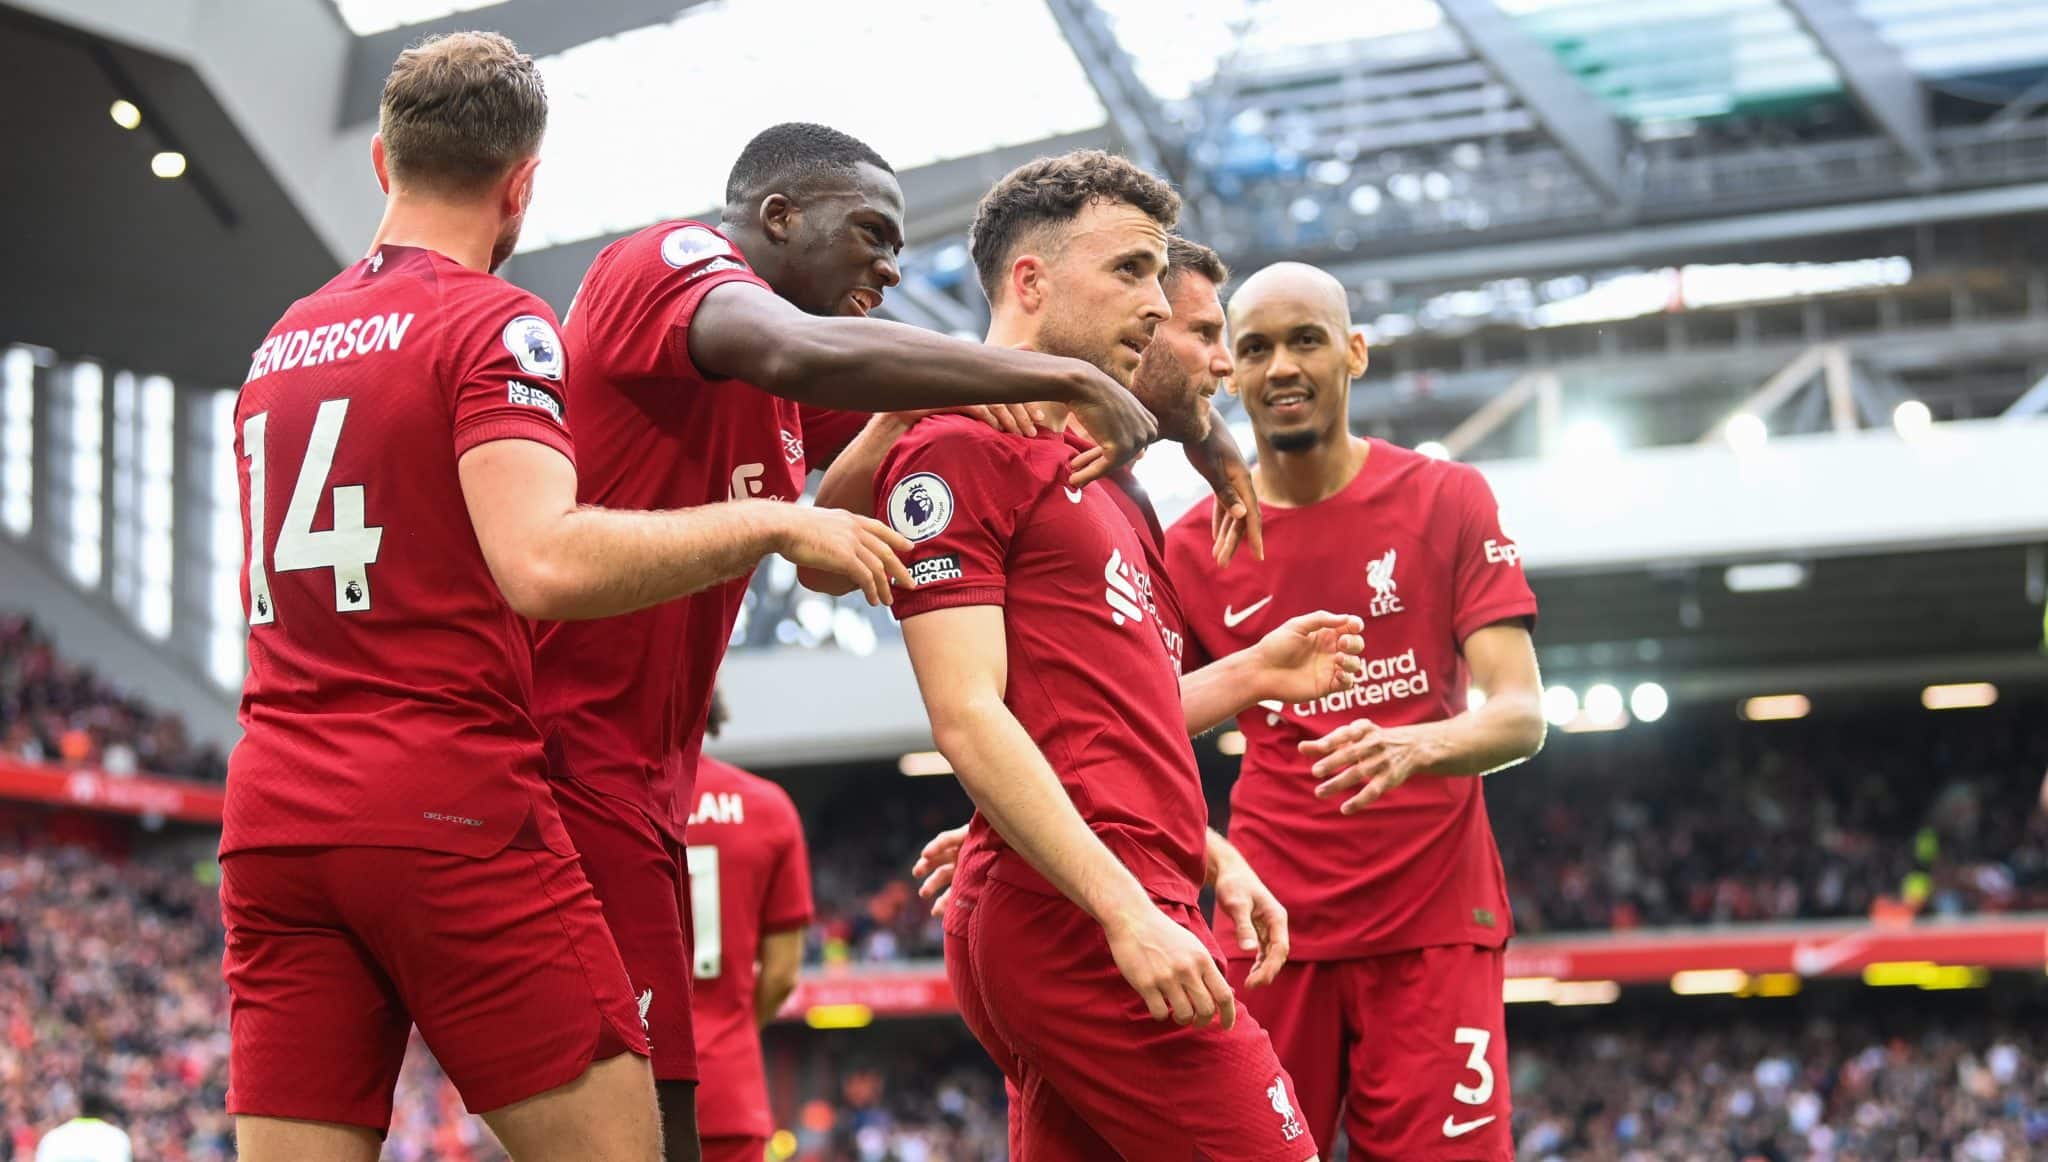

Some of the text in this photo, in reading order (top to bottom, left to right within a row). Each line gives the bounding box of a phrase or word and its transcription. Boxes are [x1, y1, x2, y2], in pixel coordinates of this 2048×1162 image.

[507, 380, 530, 396] No
[243, 398, 384, 625] 14
[914, 557, 954, 575] room
[914, 568, 962, 586] racism
[688, 791, 744, 824] AH
[1453, 1027, 1494, 1105] 3
